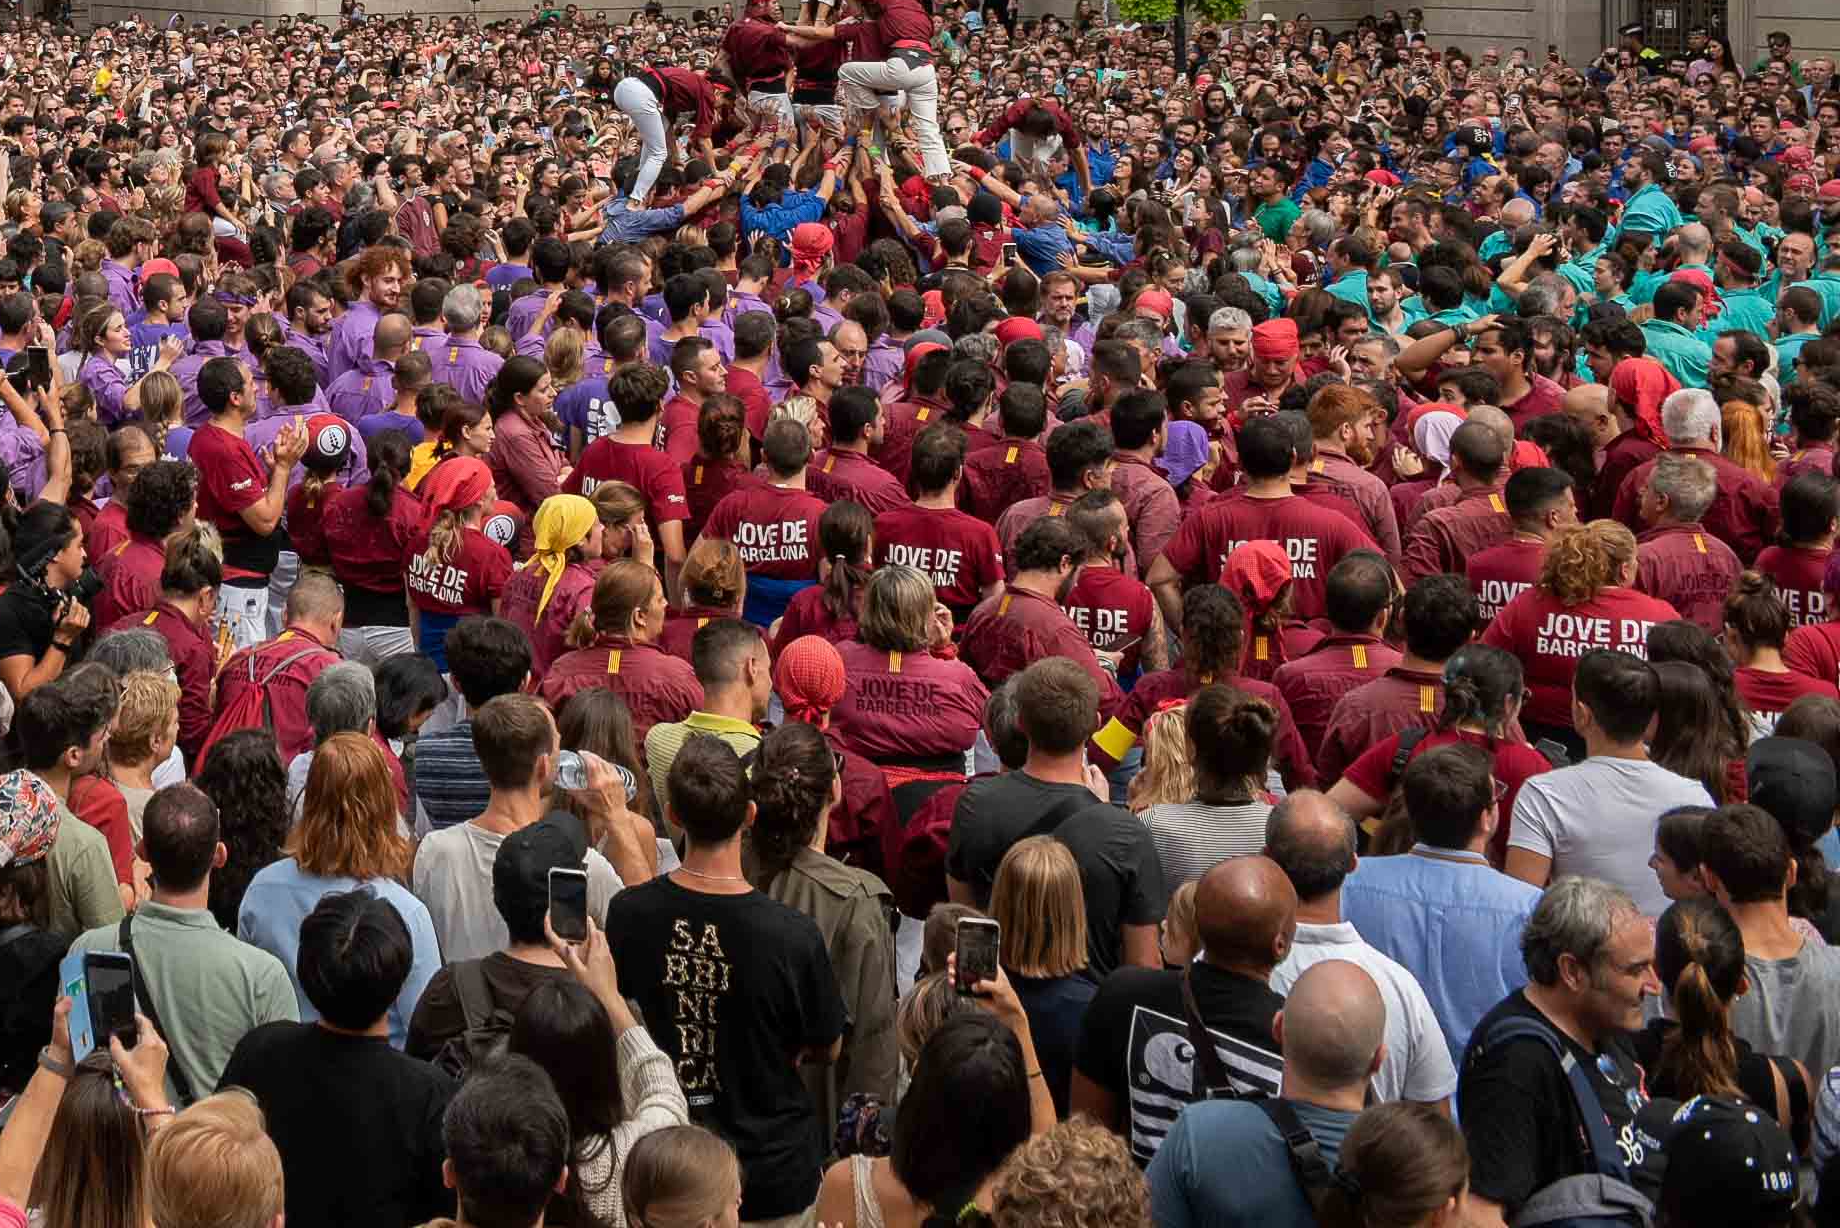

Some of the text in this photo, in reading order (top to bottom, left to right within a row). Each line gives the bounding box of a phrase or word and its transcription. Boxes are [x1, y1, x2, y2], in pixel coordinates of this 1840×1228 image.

[732, 520, 808, 546] JOVE DE
[736, 544, 809, 563] ARCLONA
[884, 543, 963, 573] JOVE DE
[1285, 538, 1318, 562] DE
[409, 553, 469, 592] JOVE DE
[409, 573, 465, 605] BRCLONA
[1060, 606, 1129, 633] VE DE
[1537, 612, 1611, 643] JOVE
[856, 678, 912, 701] JOVE
